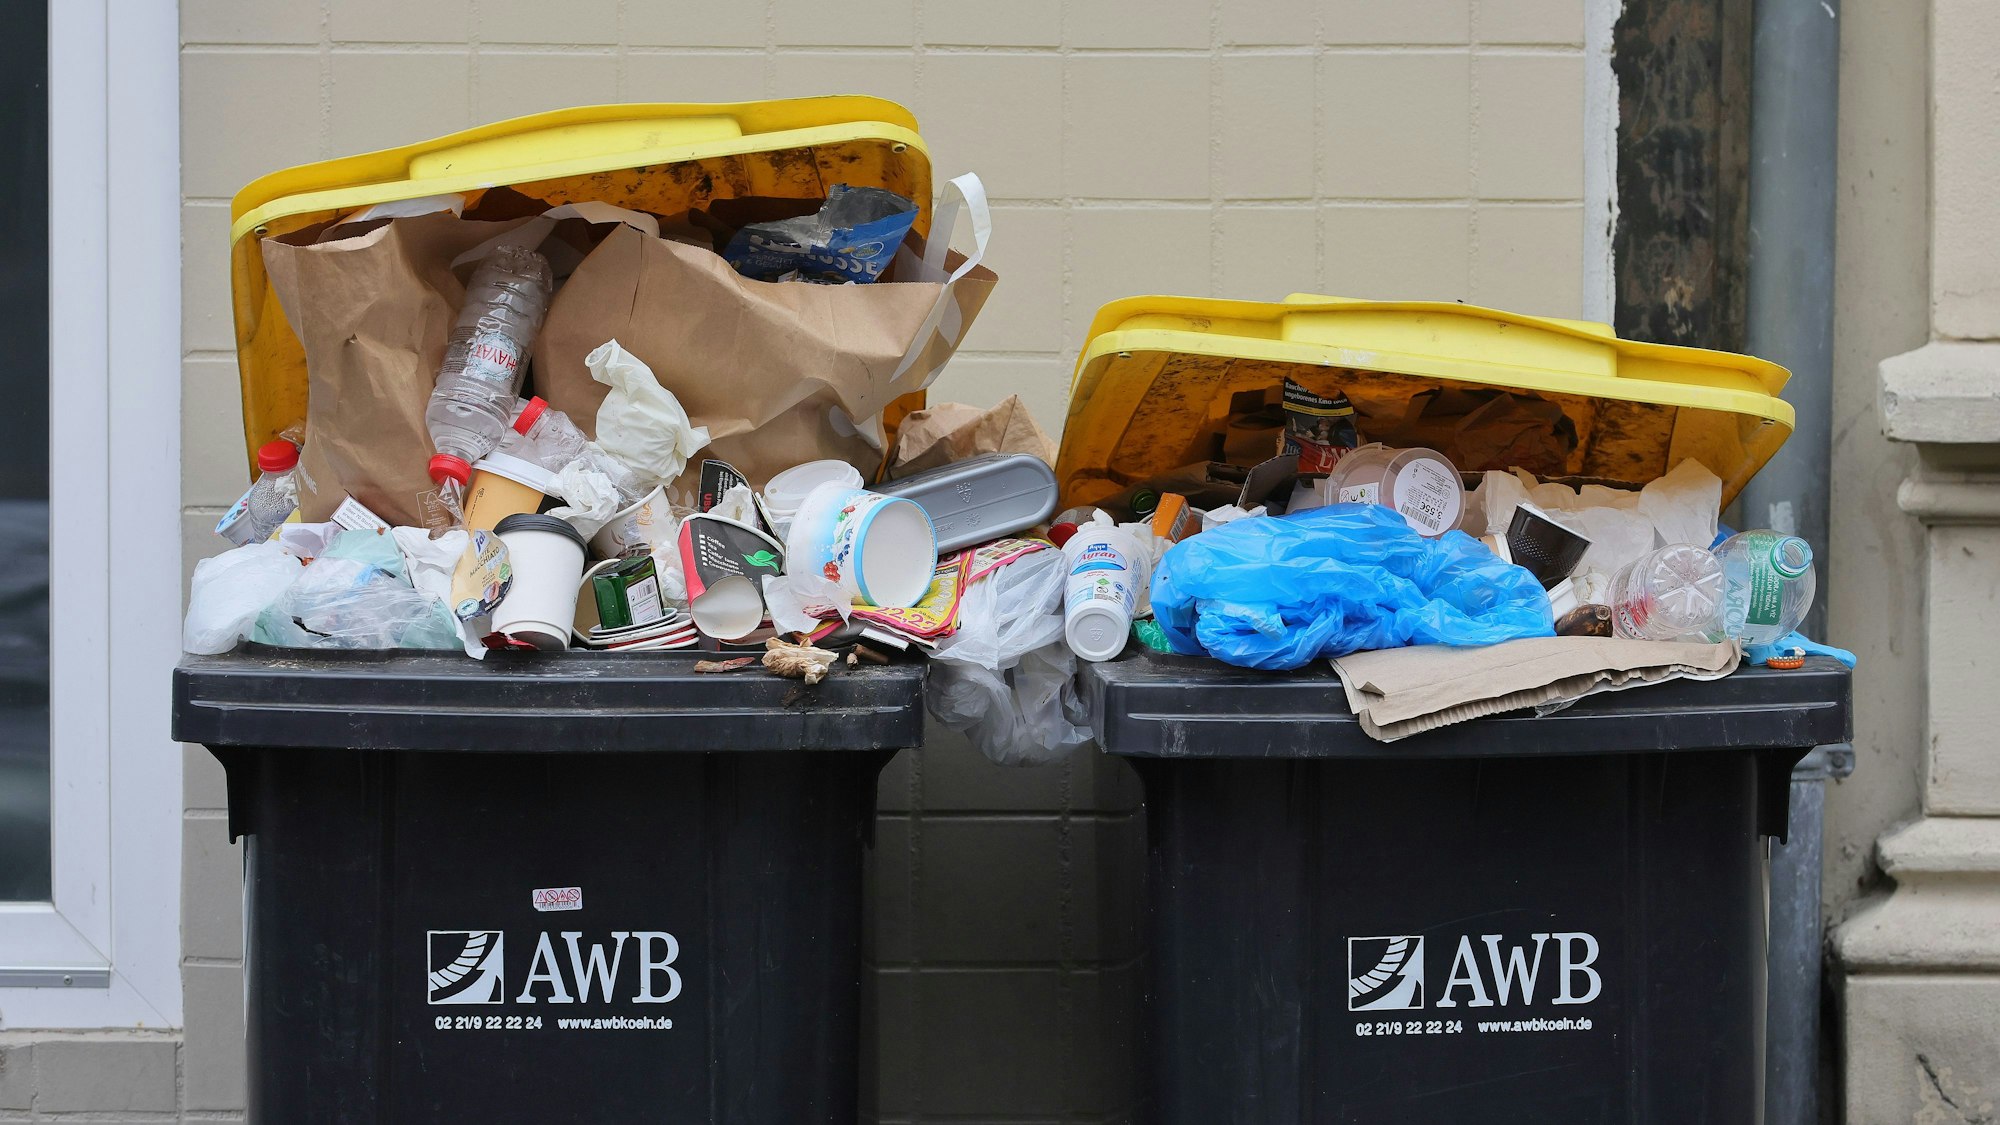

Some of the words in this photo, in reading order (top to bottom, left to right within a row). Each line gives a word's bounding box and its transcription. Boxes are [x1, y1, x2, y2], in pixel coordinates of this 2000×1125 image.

[474, 343, 516, 371] HAYAT
[706, 535, 726, 550] Coffee
[707, 541, 718, 551] Tea
[1078, 551, 1116, 564] Ayran
[516, 931, 683, 1004] AWB
[1436, 932, 1602, 1008] AWB
[435, 1016, 452, 1029] 02
[455, 1016, 482, 1029] 21/9
[486, 1016, 502, 1029] 22
[506, 1016, 522, 1029] 22
[526, 1016, 542, 1029] 24
[558, 1016, 672, 1029] www.awbkoeln.de
[1356, 1023, 1372, 1036] 02
[1376, 1022, 1402, 1035] 21/9
[1406, 1021, 1422, 1034] 22
[1426, 1021, 1442, 1034] 22
[1446, 1020, 1462, 1033] 24
[1478, 1017, 1592, 1032] www.awbkoeln.de
